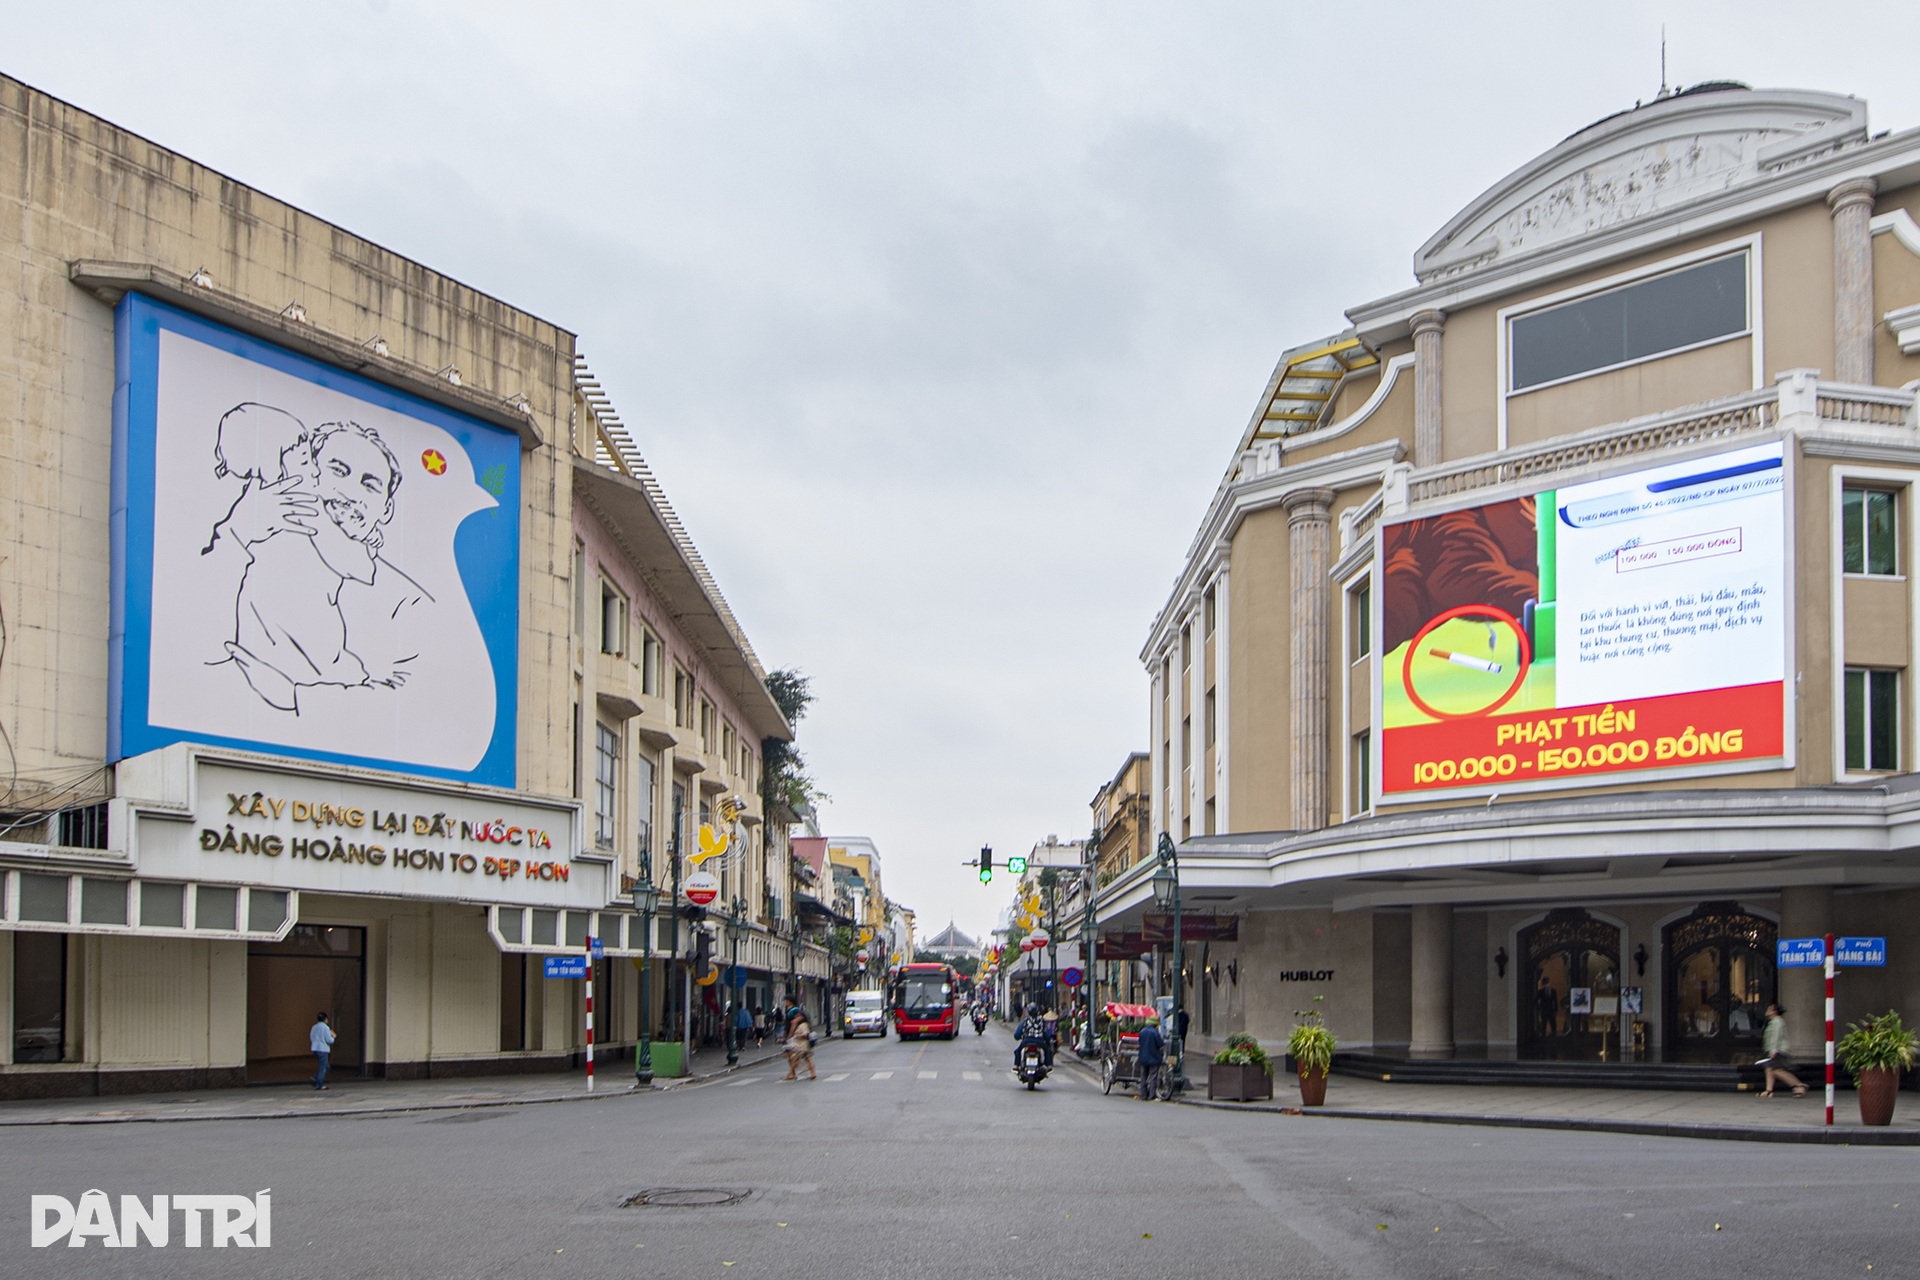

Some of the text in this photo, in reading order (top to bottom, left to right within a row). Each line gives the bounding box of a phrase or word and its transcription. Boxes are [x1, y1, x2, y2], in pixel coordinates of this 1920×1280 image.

[1497, 704, 1636, 748] PHẠT TIỀN
[1414, 726, 1743, 784] 100.000 - 150.000 ĐỒNG
[227, 791, 552, 849] XÂY DỰNG LẠI ĐẤT NƯỚC TA
[199, 823, 569, 882] ĐÀNG HOÀNG HƠN TO ĐẸP HƠN
[1797, 939, 1813, 949] PHỐ
[1855, 939, 1872, 948] PHỐ
[1806, 948, 1822, 963] TIỀN
[1837, 949, 1882, 962] HÀNG BÀI
[1280, 969, 1334, 982] HUBLOT
